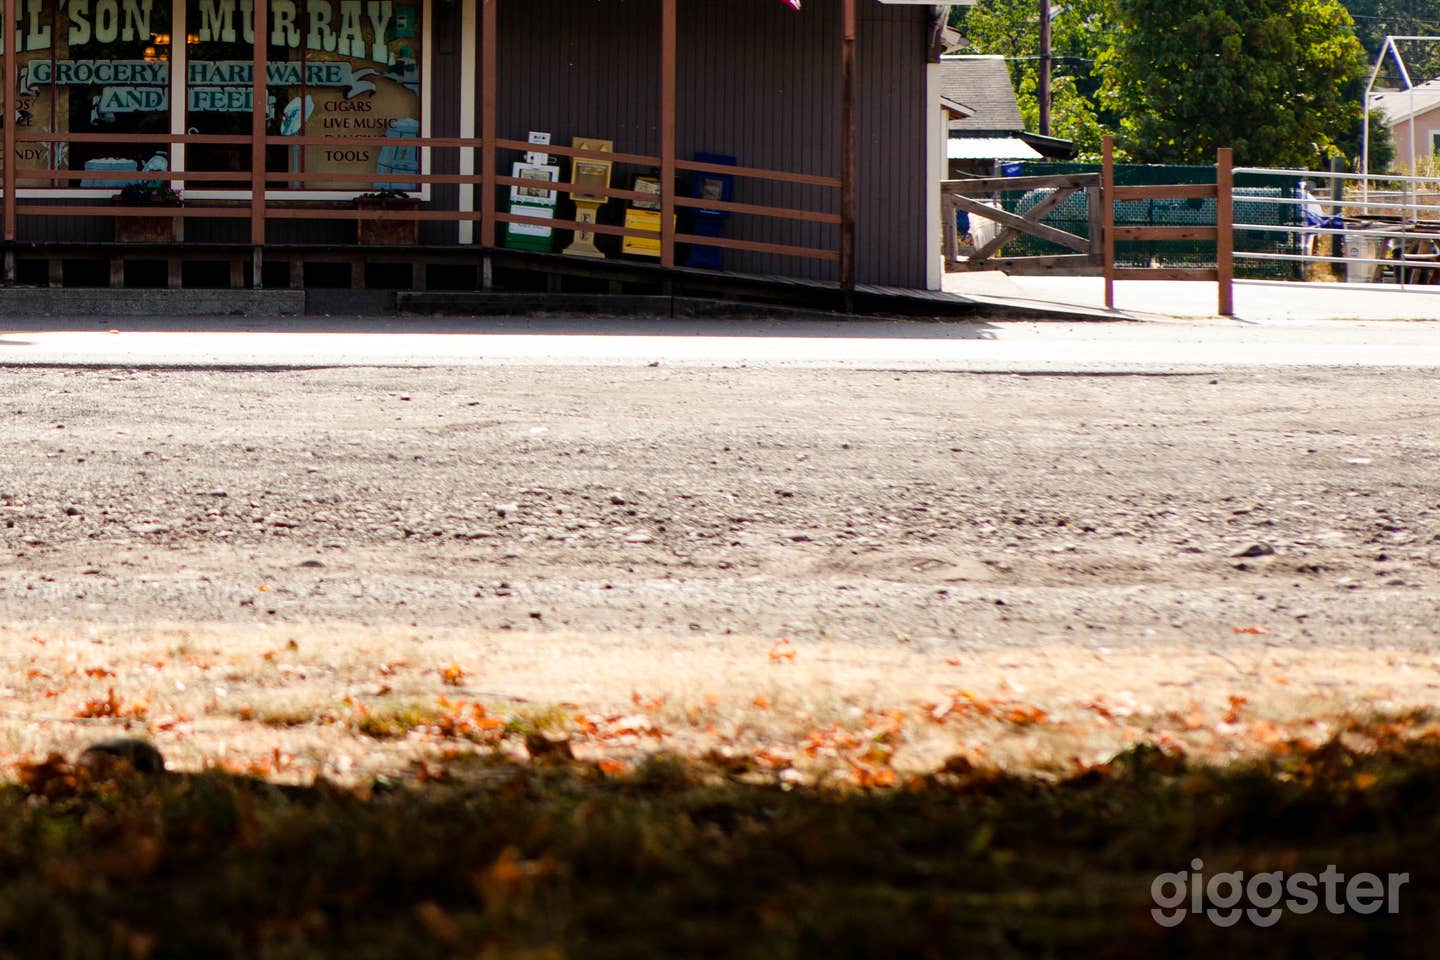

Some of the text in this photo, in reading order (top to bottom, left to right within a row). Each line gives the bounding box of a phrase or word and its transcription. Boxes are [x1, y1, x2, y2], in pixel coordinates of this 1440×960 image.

[33, 64, 341, 83] GROCERY, HARWARE
[106, 90, 253, 109] AND FEE
[324, 101, 372, 112] CIGARS
[323, 118, 398, 129] LIVE MUSIC
[326, 151, 369, 161] TOOLS
